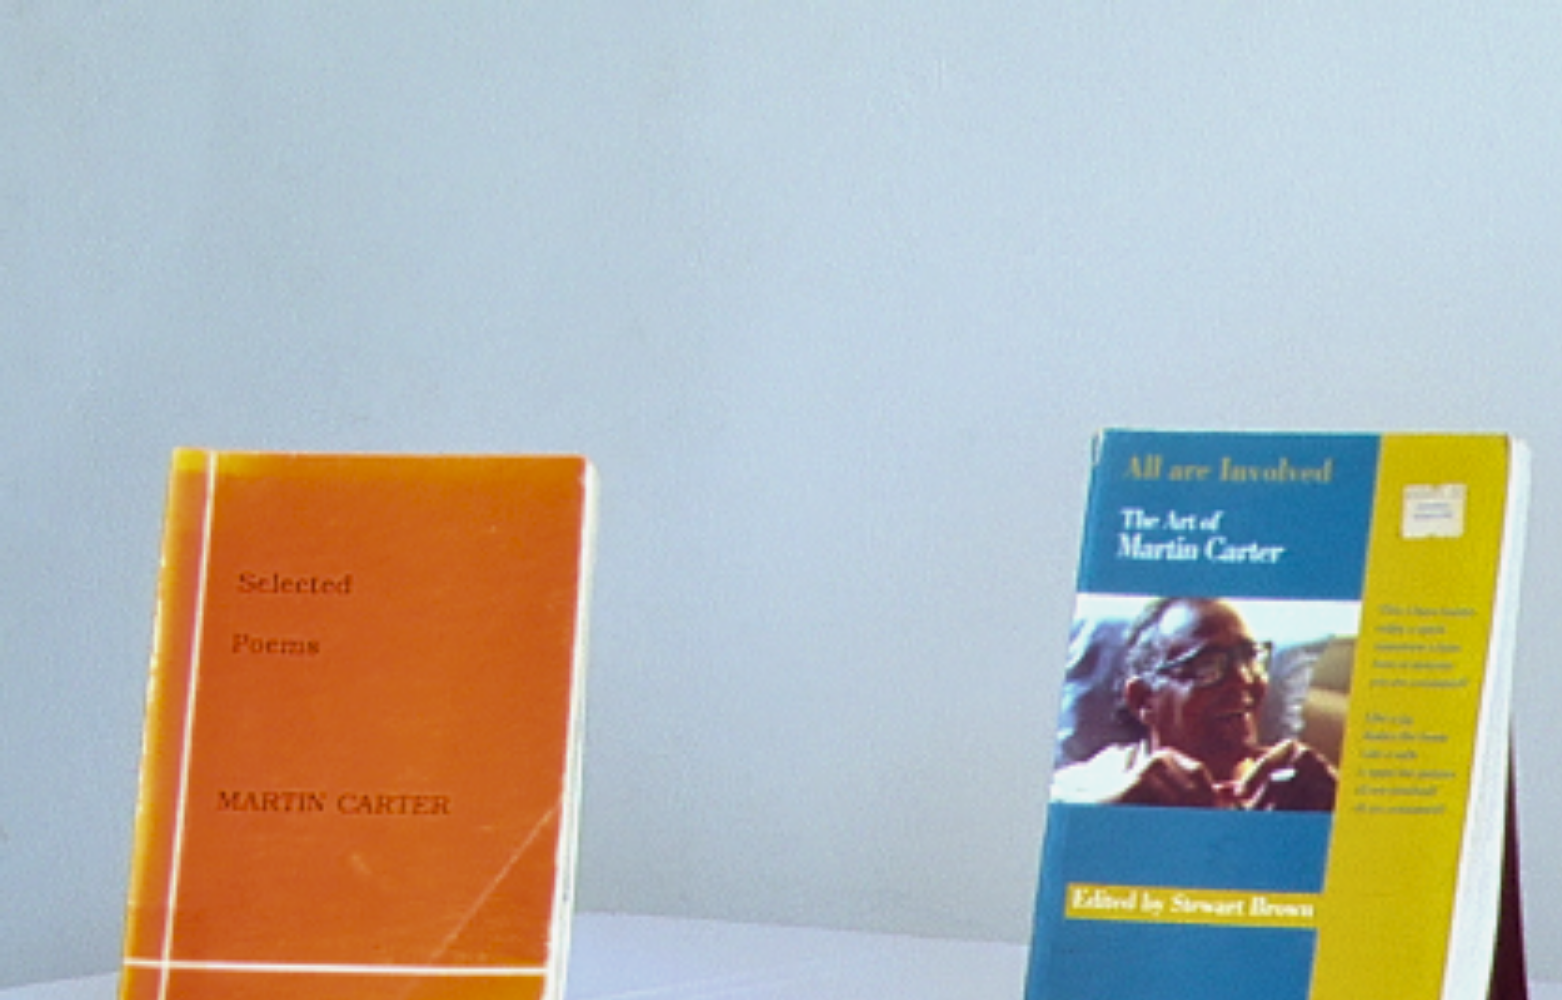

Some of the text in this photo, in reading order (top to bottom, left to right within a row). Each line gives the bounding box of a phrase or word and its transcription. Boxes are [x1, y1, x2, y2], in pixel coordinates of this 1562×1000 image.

[1124, 454, 1333, 483] All are Involved
[1120, 507, 1224, 532] The Art of
[1117, 532, 1285, 565] Martin Carter
[236, 572, 353, 595] Selected
[231, 632, 320, 656] Poems
[216, 789, 452, 817] MARTIN CARTER
[1072, 887, 1315, 920] Edited by Stewart Brown
